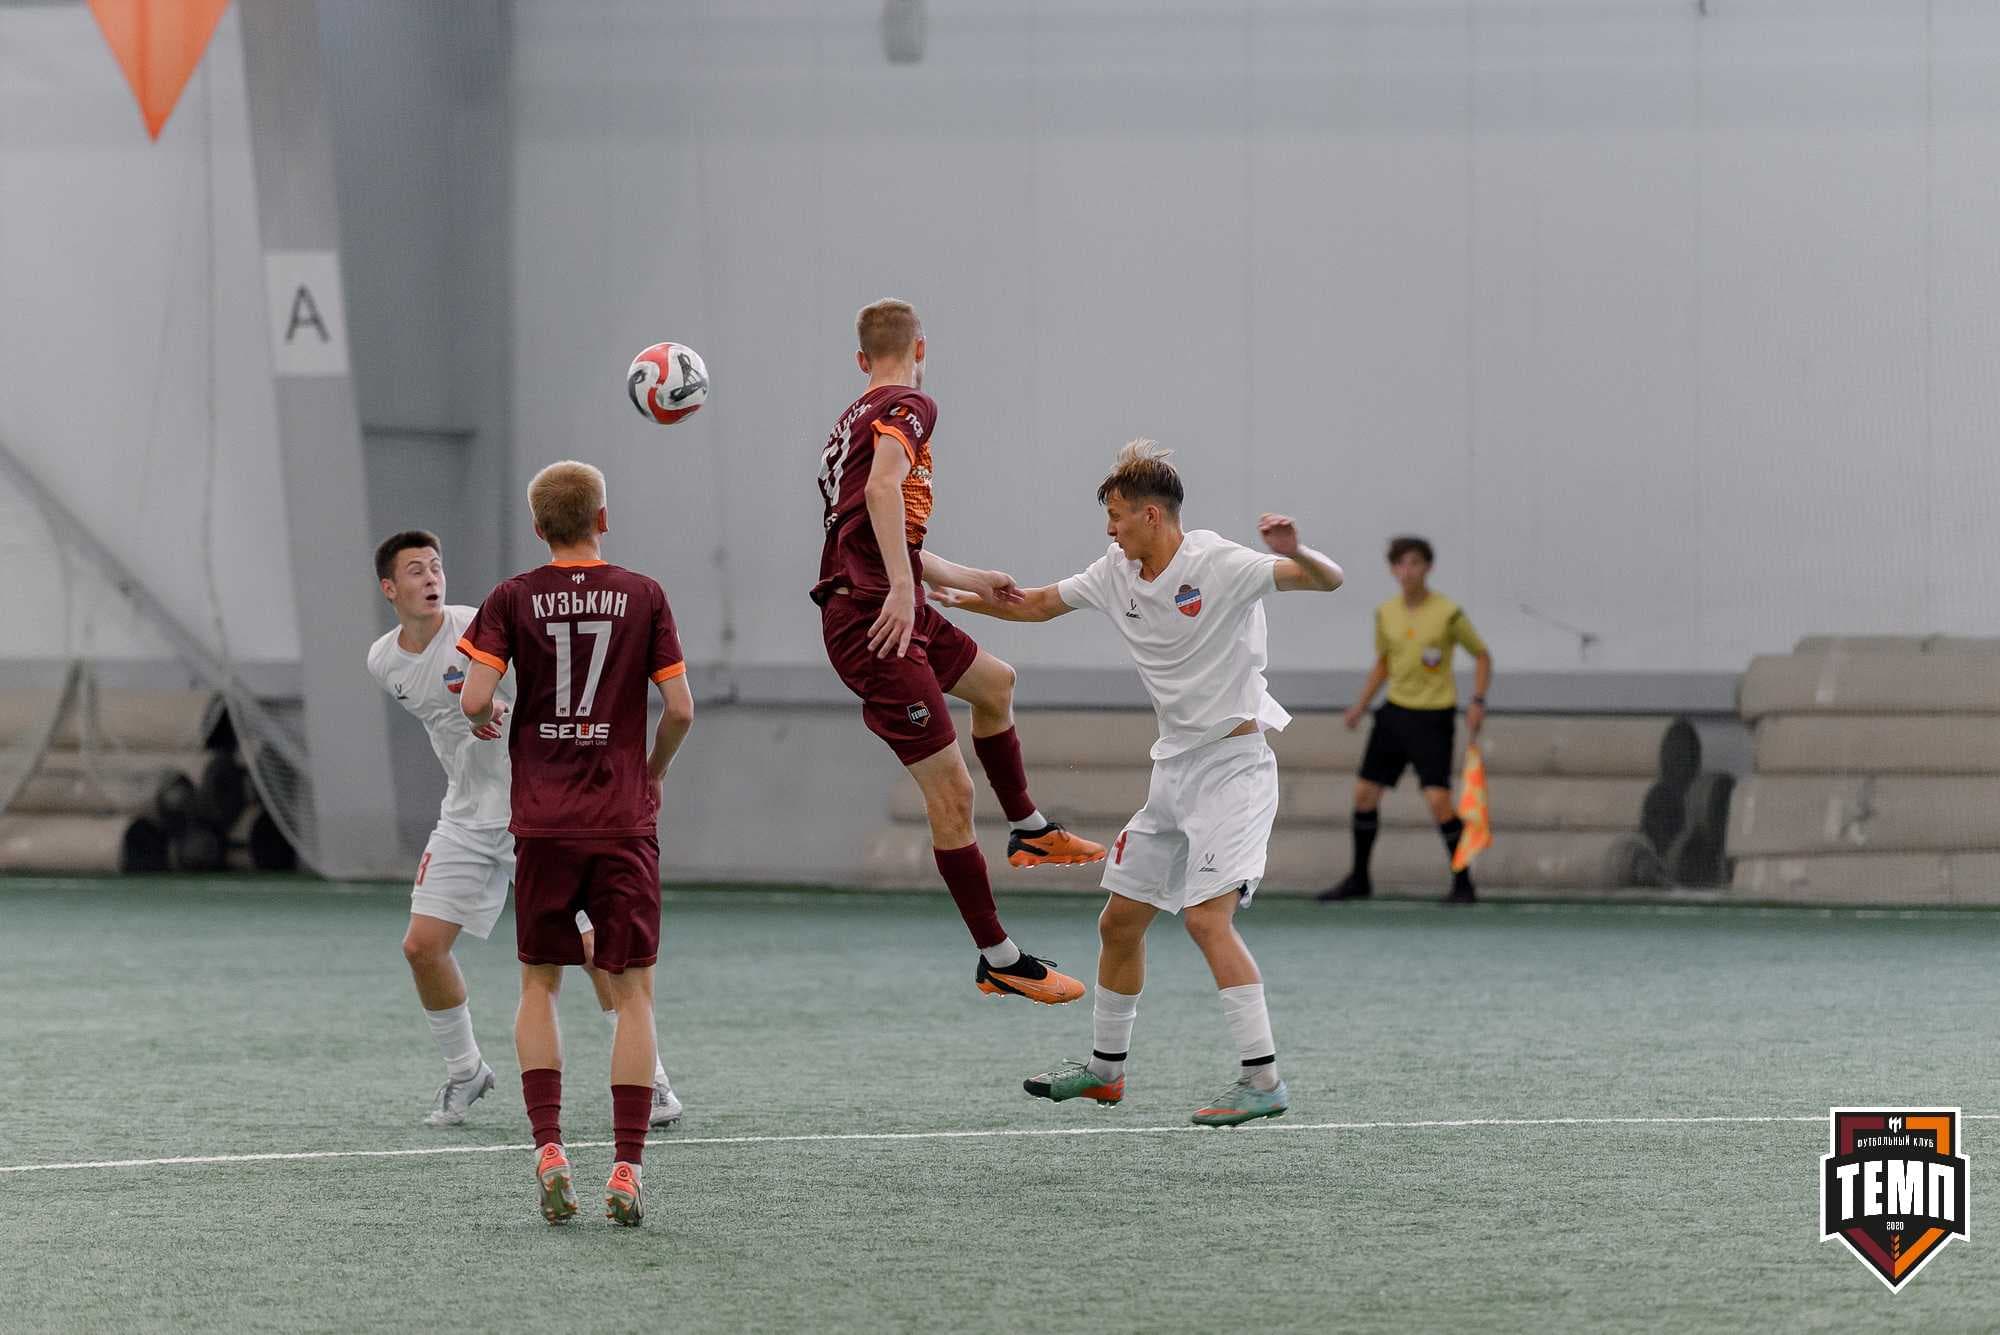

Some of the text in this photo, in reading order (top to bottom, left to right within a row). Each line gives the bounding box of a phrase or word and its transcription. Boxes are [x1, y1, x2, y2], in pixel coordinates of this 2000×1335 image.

[532, 590, 628, 619] КУЗЬКИН
[546, 620, 612, 717] 17
[539, 723, 610, 739] SEUS
